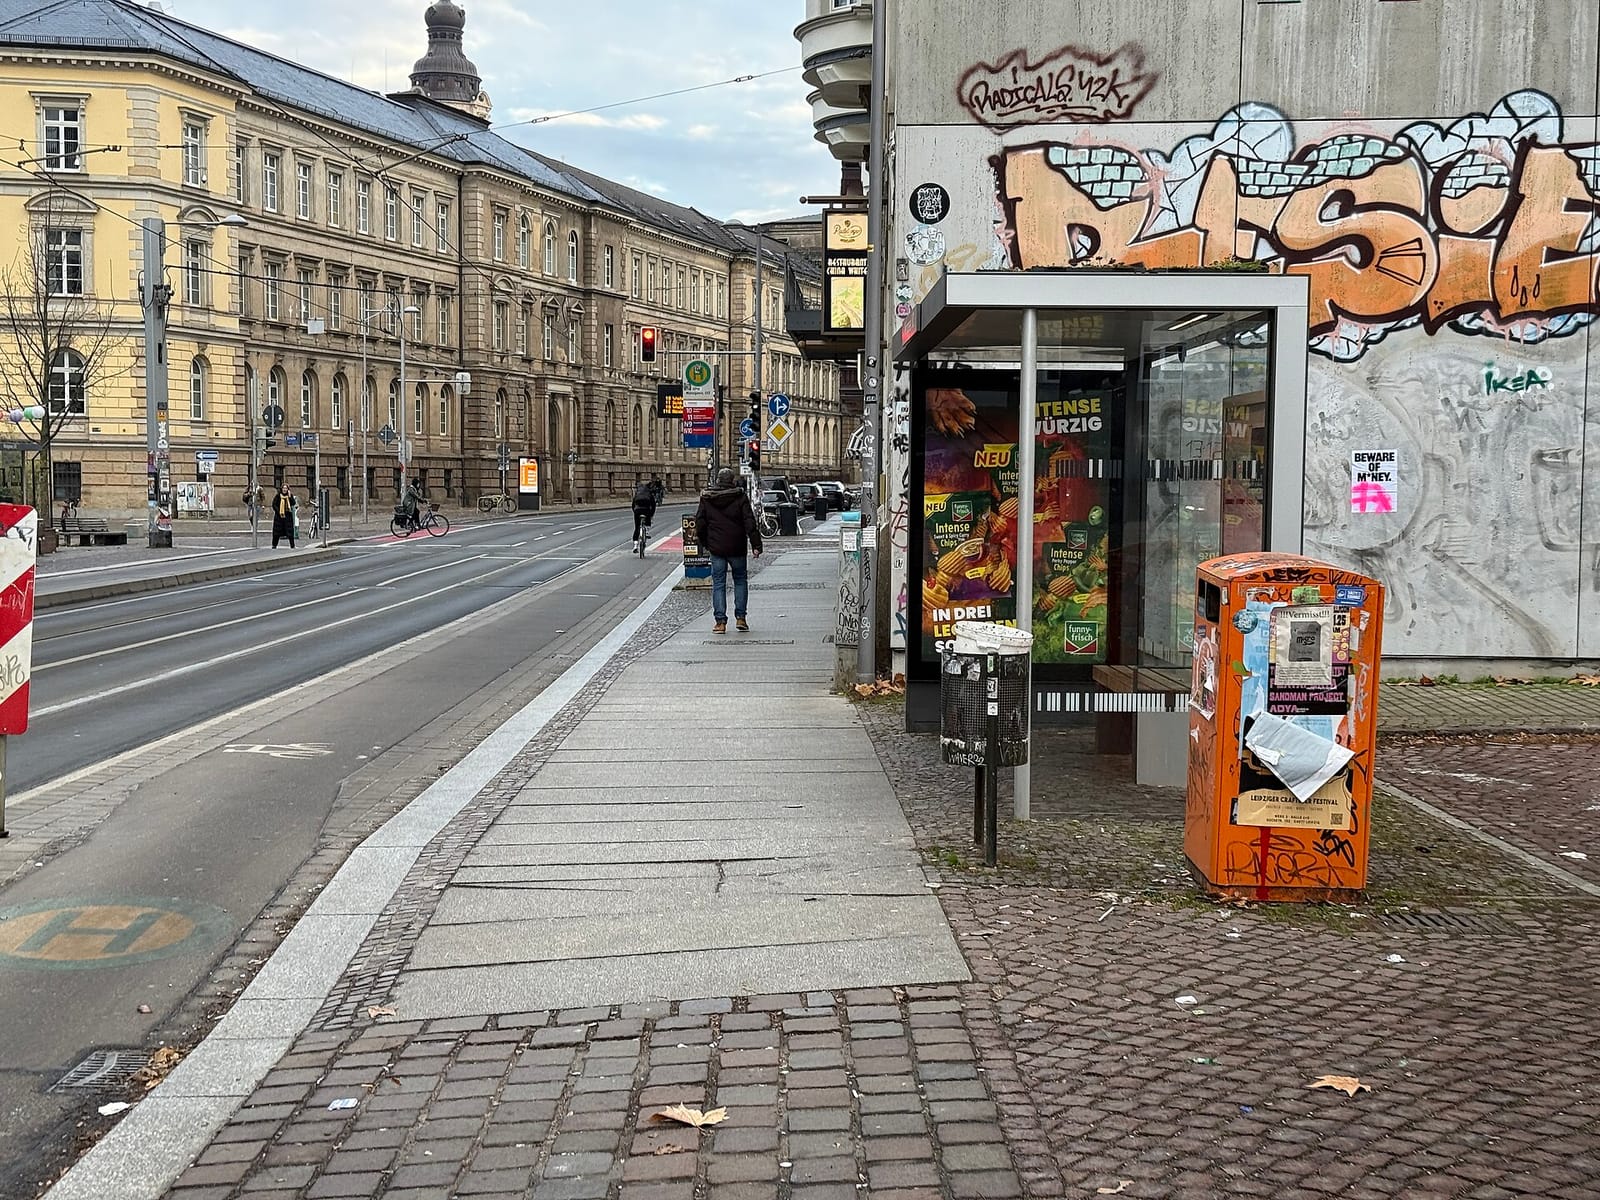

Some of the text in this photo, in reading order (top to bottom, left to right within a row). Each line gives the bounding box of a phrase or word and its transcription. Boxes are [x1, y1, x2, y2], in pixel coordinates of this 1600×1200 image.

[827, 267, 846, 275] CHINA
[976, 451, 1010, 467] NEU
[1354, 452, 1395, 462] BEWARE
[1368, 462, 1381, 471] OF
[926, 503, 946, 511] NEU
[935, 523, 970, 533] Intense
[940, 539, 957, 548] Chips
[1050, 547, 1083, 559] Intense
[1053, 563, 1070, 572] Chips
[932, 605, 991, 621] IN DREI
[1068, 624, 1093, 634] funny-
[1071, 632, 1093, 642] frisch
[1269, 692, 1345, 702] SANDMAN PROJECT
[1269, 704, 1297, 713] ADYA
[1250, 794, 1279, 803] LEIPZIGER
[15, 910, 164, 953] H
